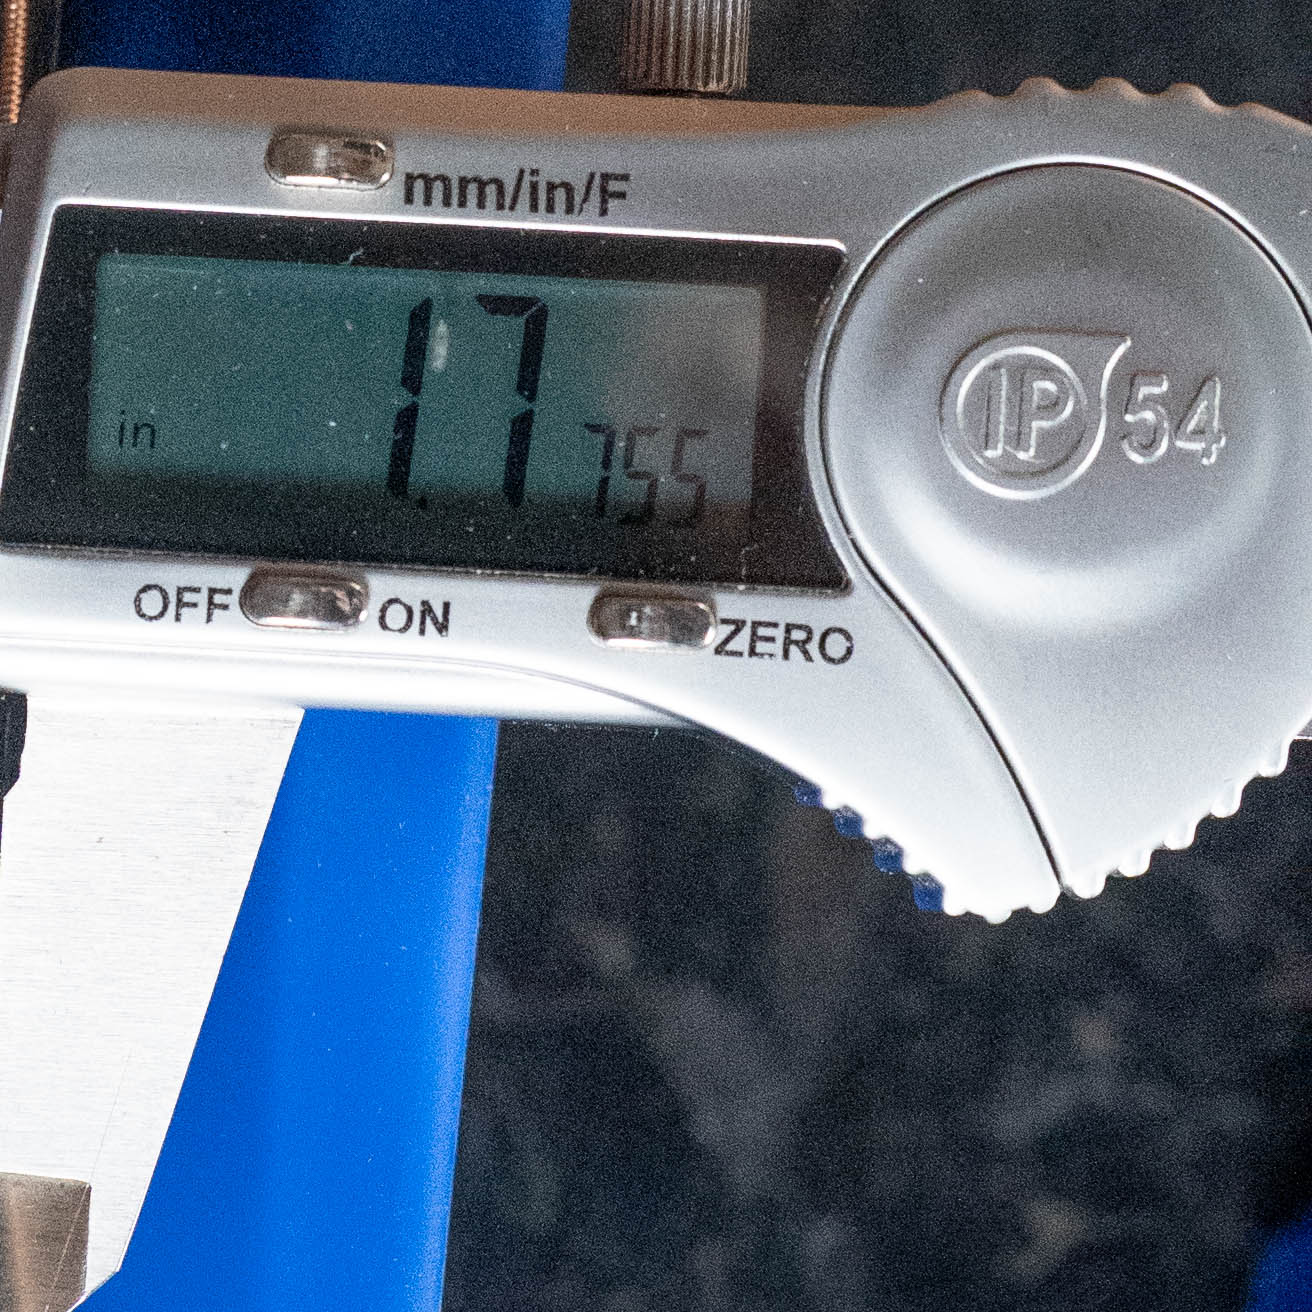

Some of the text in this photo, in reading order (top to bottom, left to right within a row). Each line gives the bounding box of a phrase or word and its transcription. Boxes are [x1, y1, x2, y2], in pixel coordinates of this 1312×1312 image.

[402, 167, 633, 217] mm/in/F
[117, 410, 157, 451] in
[982, 367, 1228, 466] IP 54
[132, 583, 233, 624] OFF
[378, 596, 451, 637] ON
[713, 618, 855, 665] ZERO
